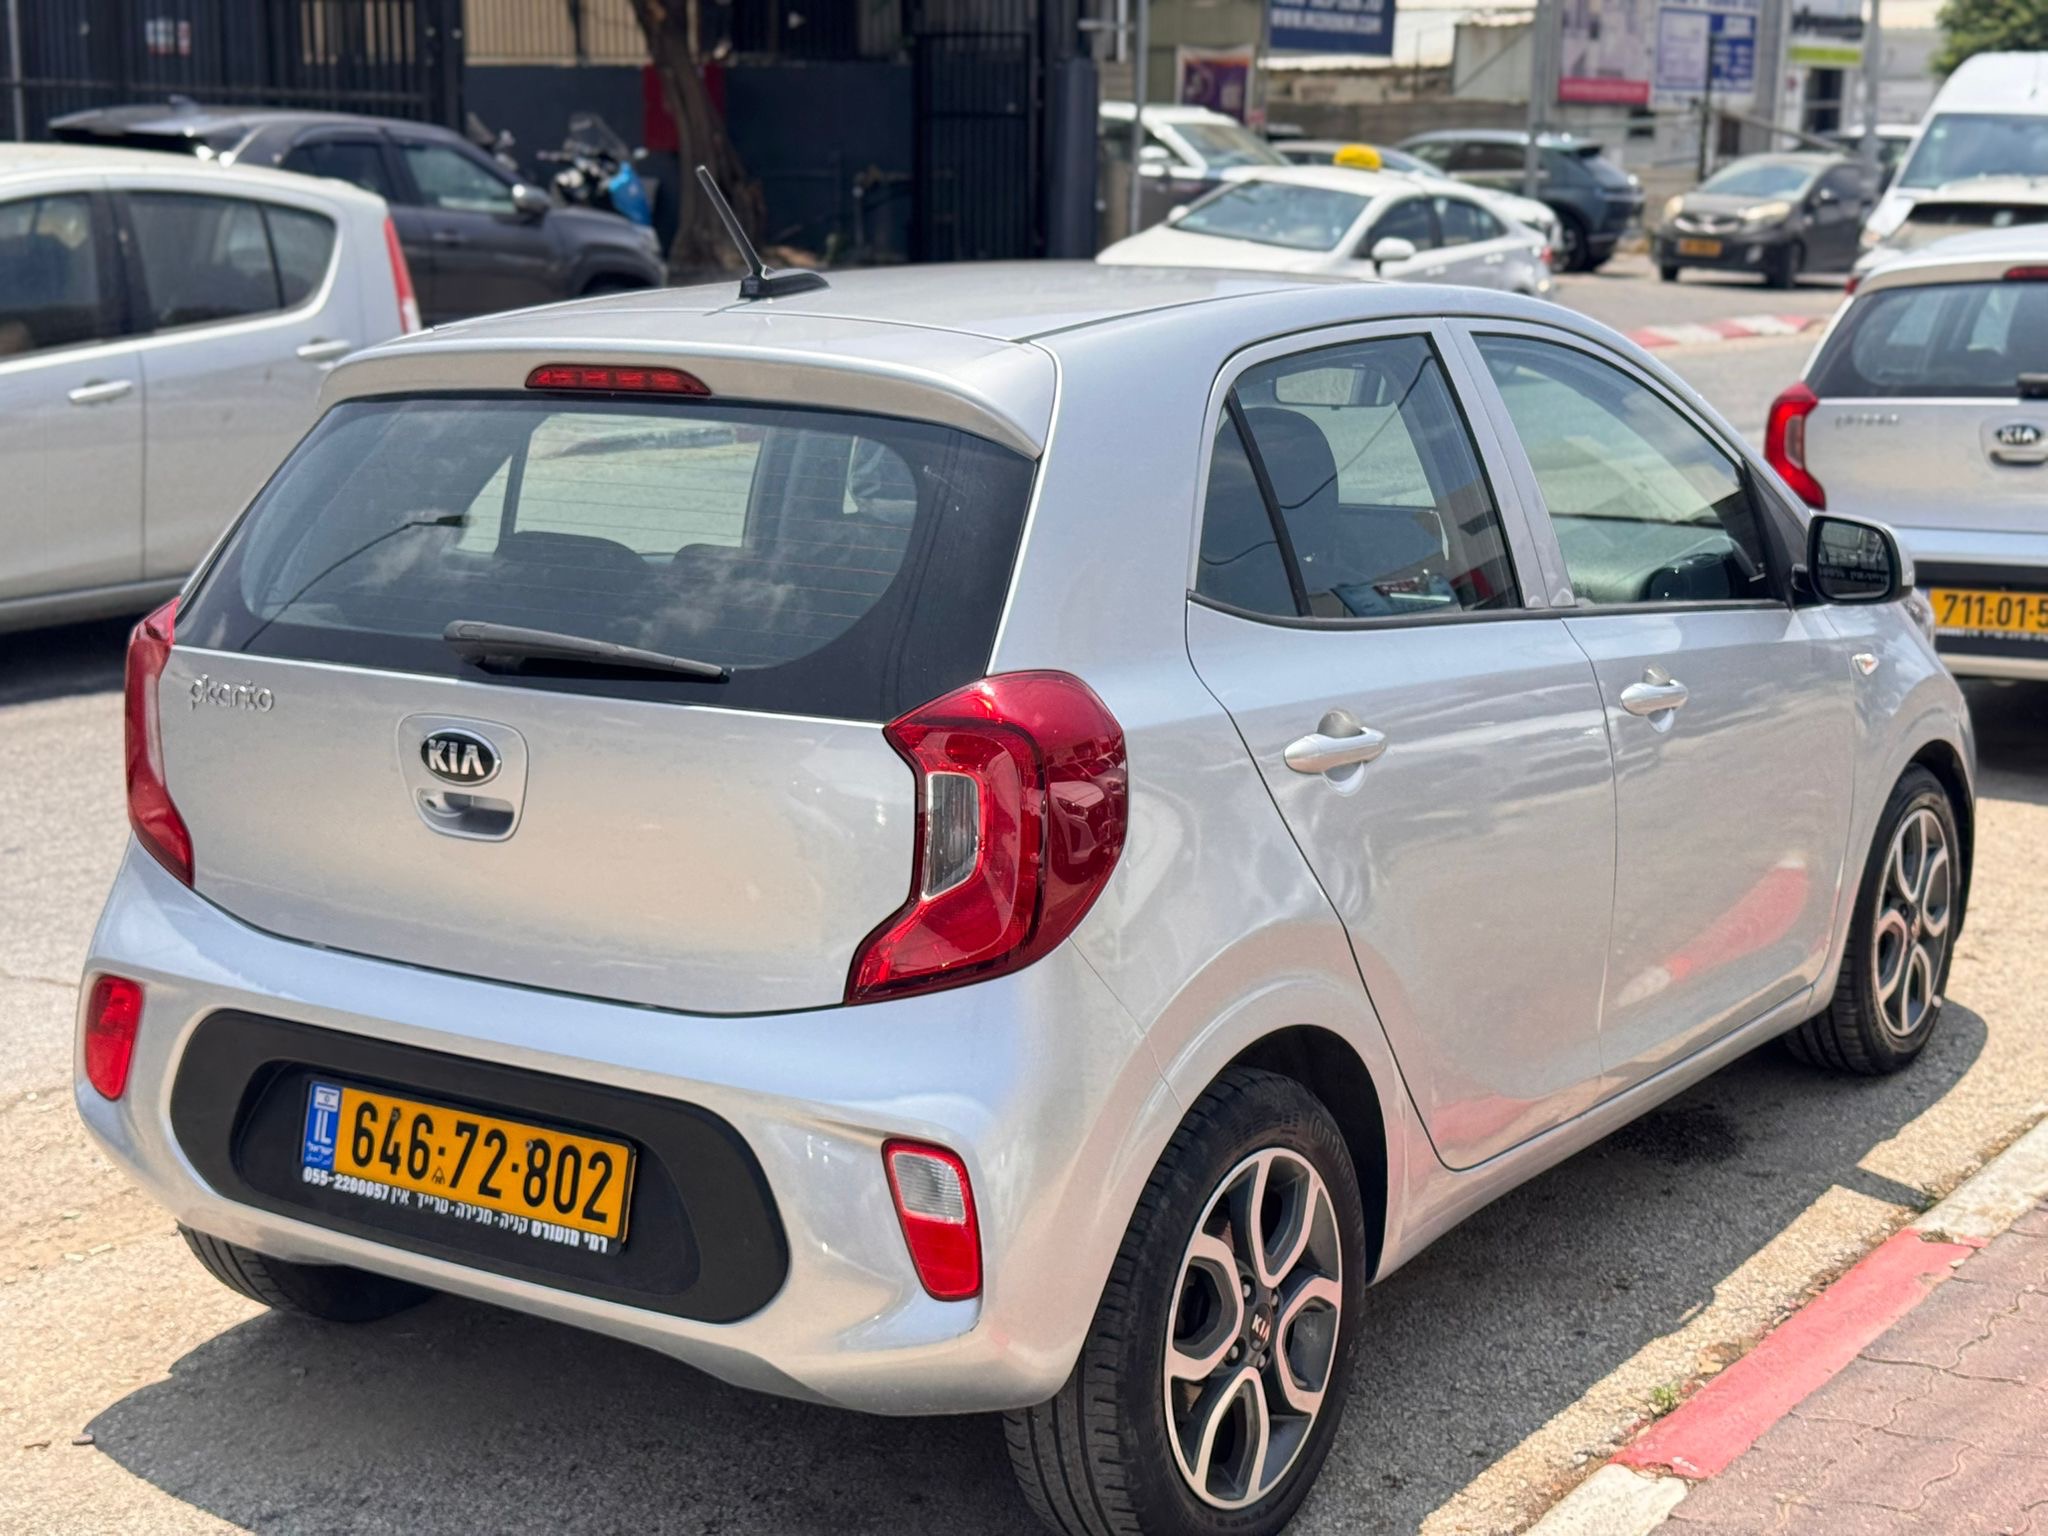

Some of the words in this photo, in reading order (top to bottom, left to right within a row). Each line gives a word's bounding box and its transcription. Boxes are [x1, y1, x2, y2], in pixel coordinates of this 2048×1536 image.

[2001, 425, 2036, 444] KIA
[427, 739, 485, 776] KIA
[314, 1110, 332, 1145] IL
[531, 1220, 580, 1247] מוטורס
[583, 1232, 608, 1253] רמי
[1251, 1313, 1270, 1342] KIA
